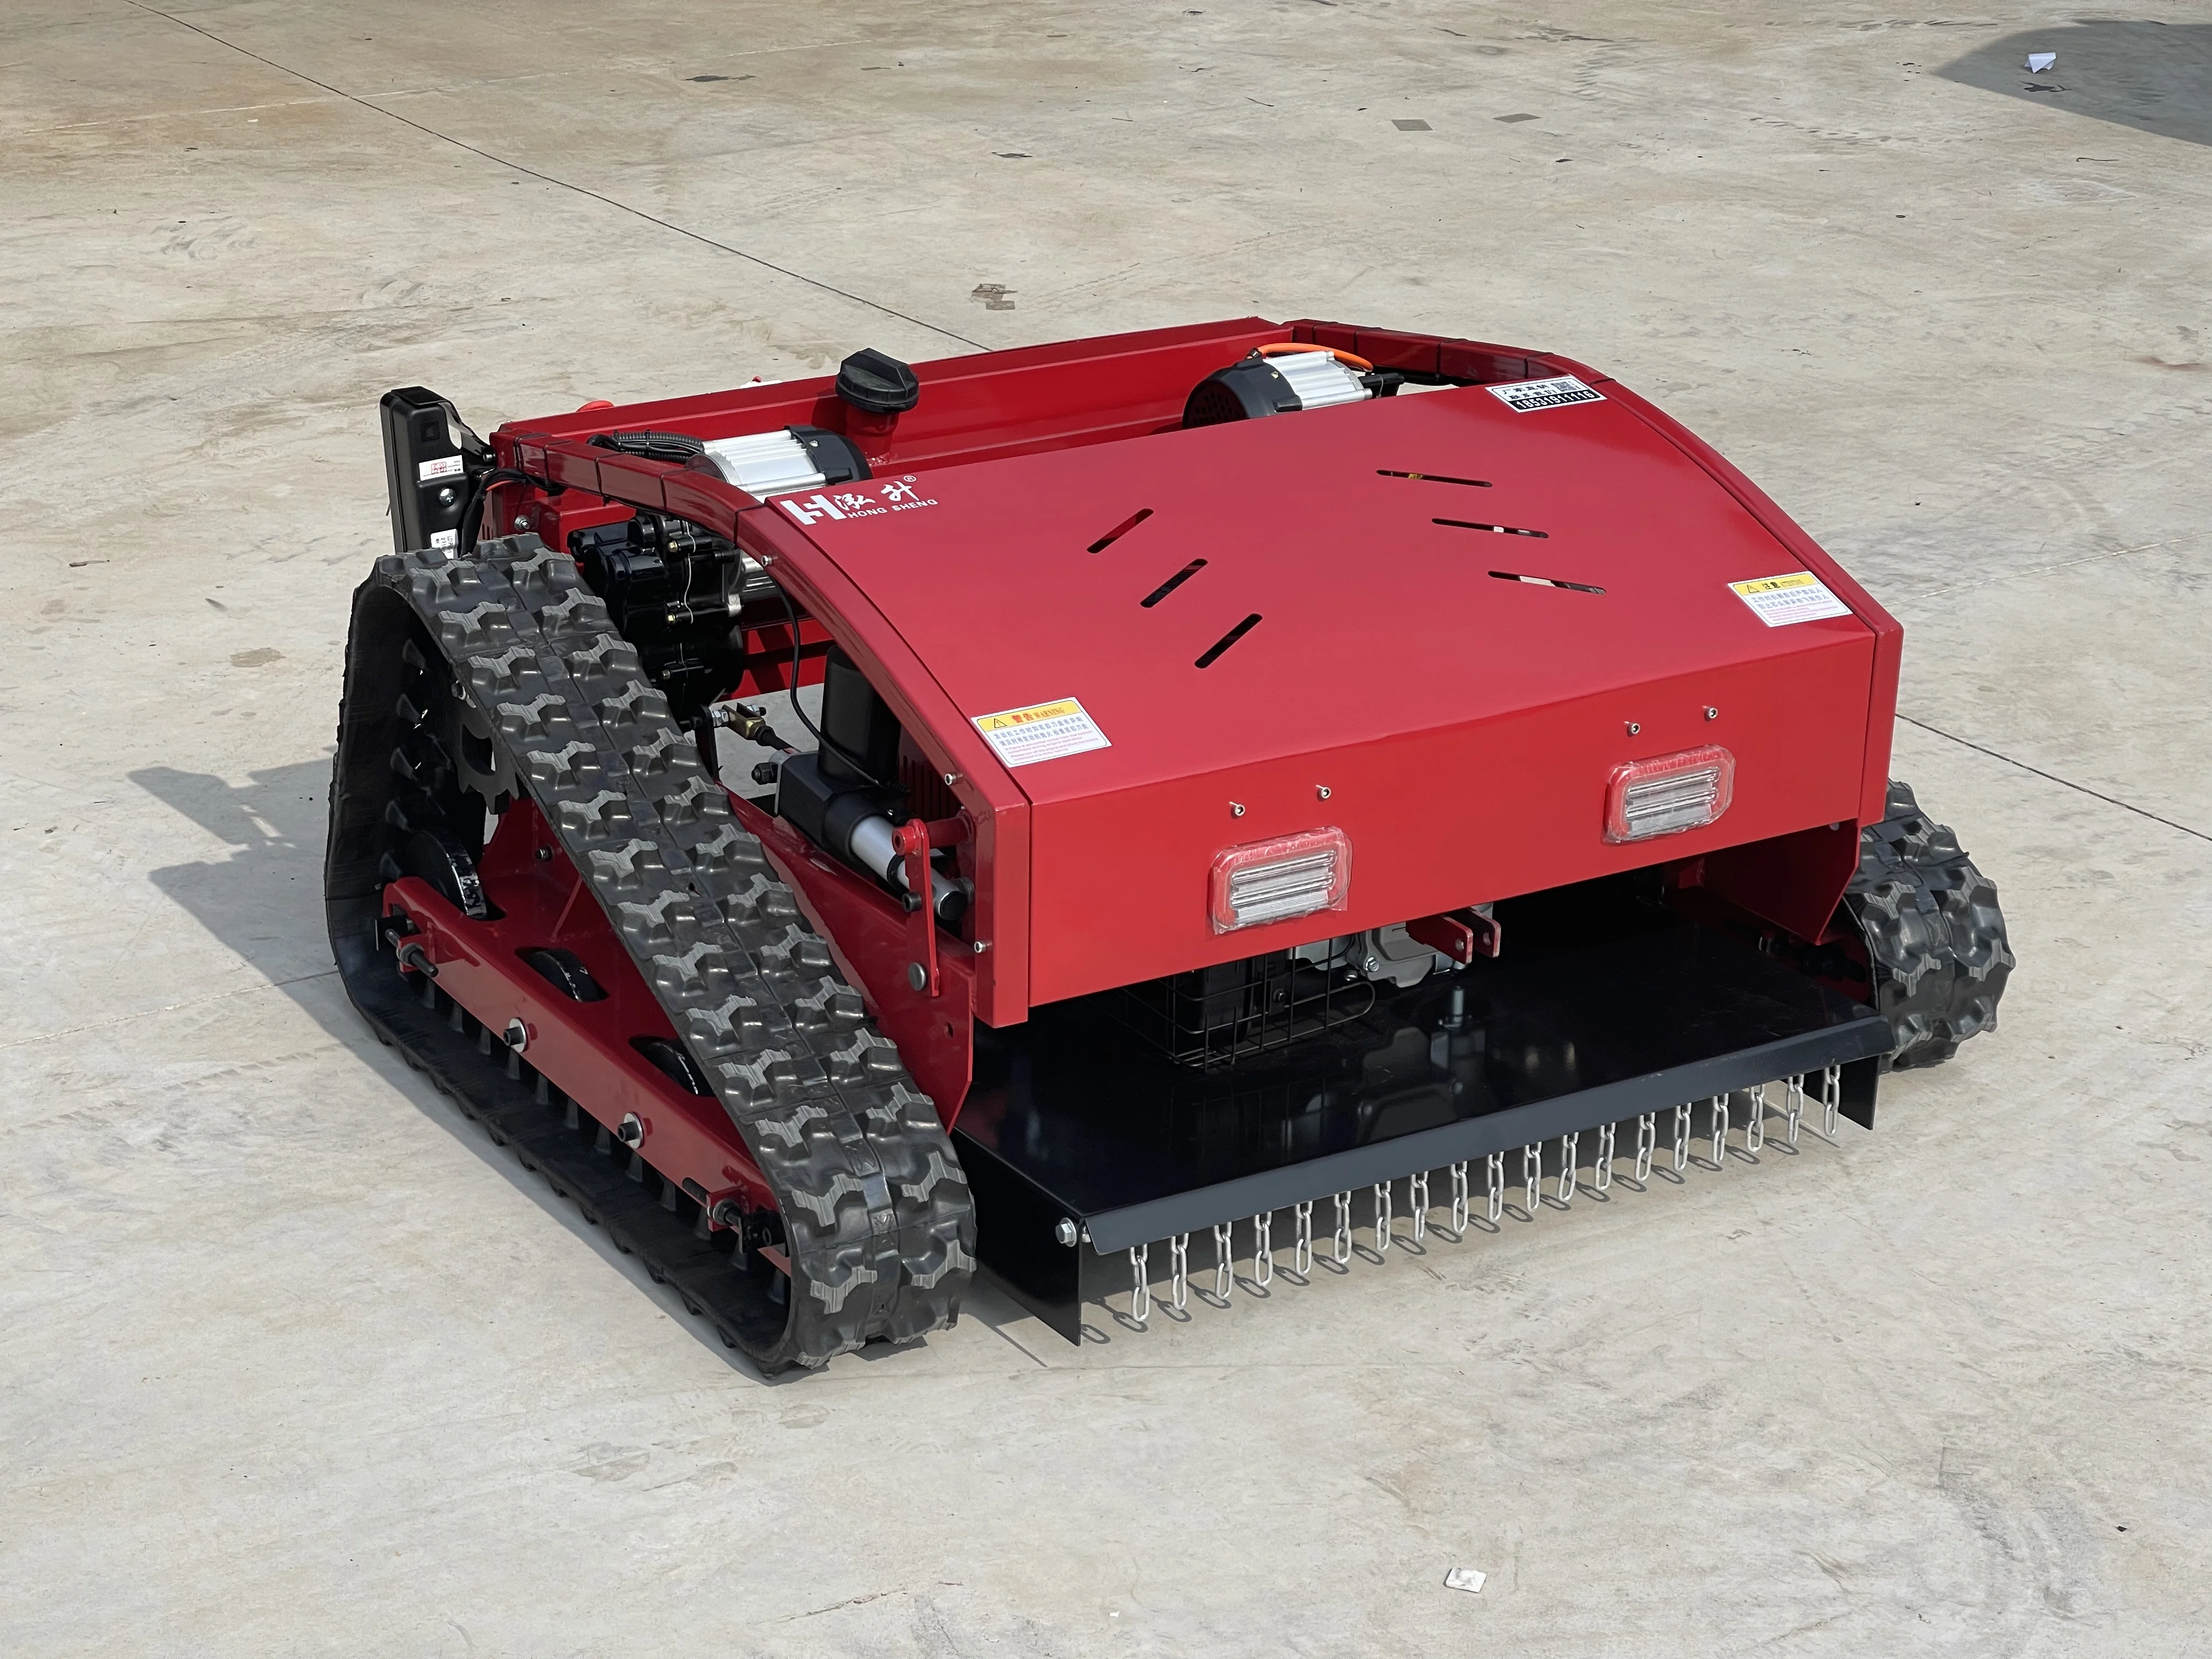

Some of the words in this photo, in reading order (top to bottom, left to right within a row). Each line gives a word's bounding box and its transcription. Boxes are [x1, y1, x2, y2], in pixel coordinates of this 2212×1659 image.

[1516, 391, 1595, 409] 18531911116
[848, 507, 888, 518] HONG
[892, 499, 938, 511] SHENG
[1762, 582, 1781, 590] 注意
[1011, 712, 1034, 723] 警告
[1034, 707, 1065, 719] WARNING
